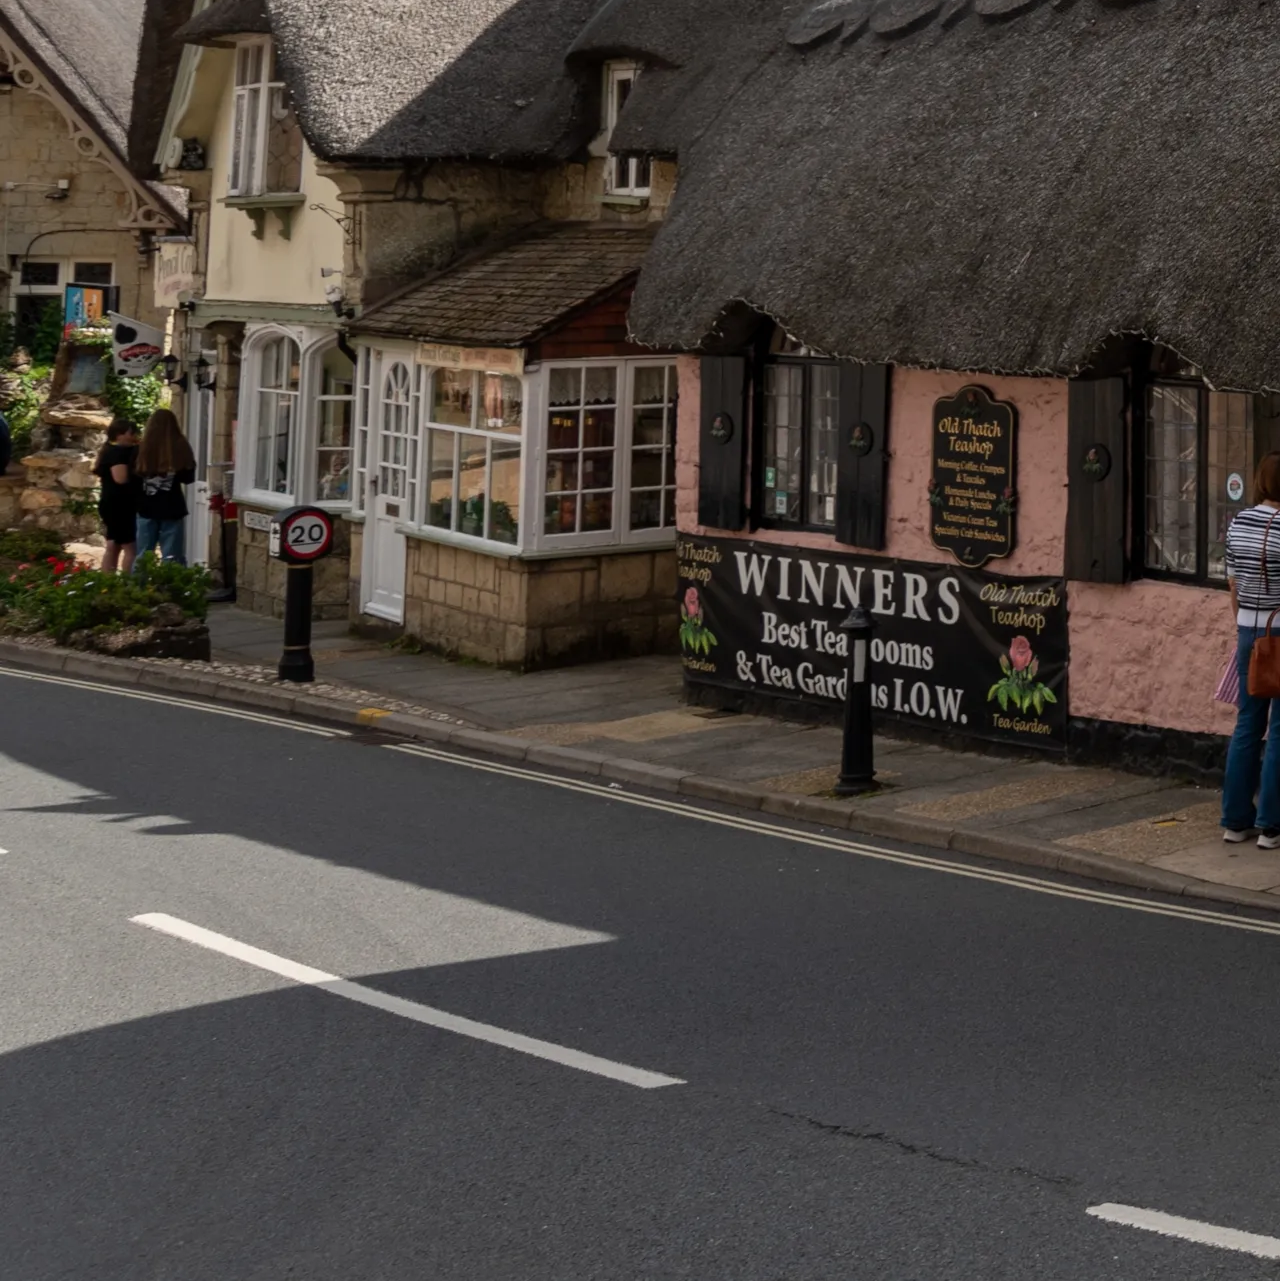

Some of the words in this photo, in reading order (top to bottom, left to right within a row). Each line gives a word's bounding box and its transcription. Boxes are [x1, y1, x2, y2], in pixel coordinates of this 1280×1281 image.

[939, 417, 961, 434] Old
[962, 418, 1002, 438] Thatch
[948, 435, 994, 460] Teashop
[291, 524, 324, 544] 20
[684, 542, 723, 564] Thatch
[733, 550, 960, 625] WINNERS
[979, 582, 1009, 603] Old
[1009, 584, 1060, 607] Thatch
[990, 606, 1046, 635] Teashop
[761, 611, 809, 650] Best
[811, 618, 849, 657] Tea
[870, 637, 934, 671] ooms
[736, 650, 757, 683] &
[756, 653, 796, 690] Tea
[893, 678, 969, 725] I.O.W.
[992, 713, 1013, 729] Tea
[1013, 716, 1052, 735] Garden
